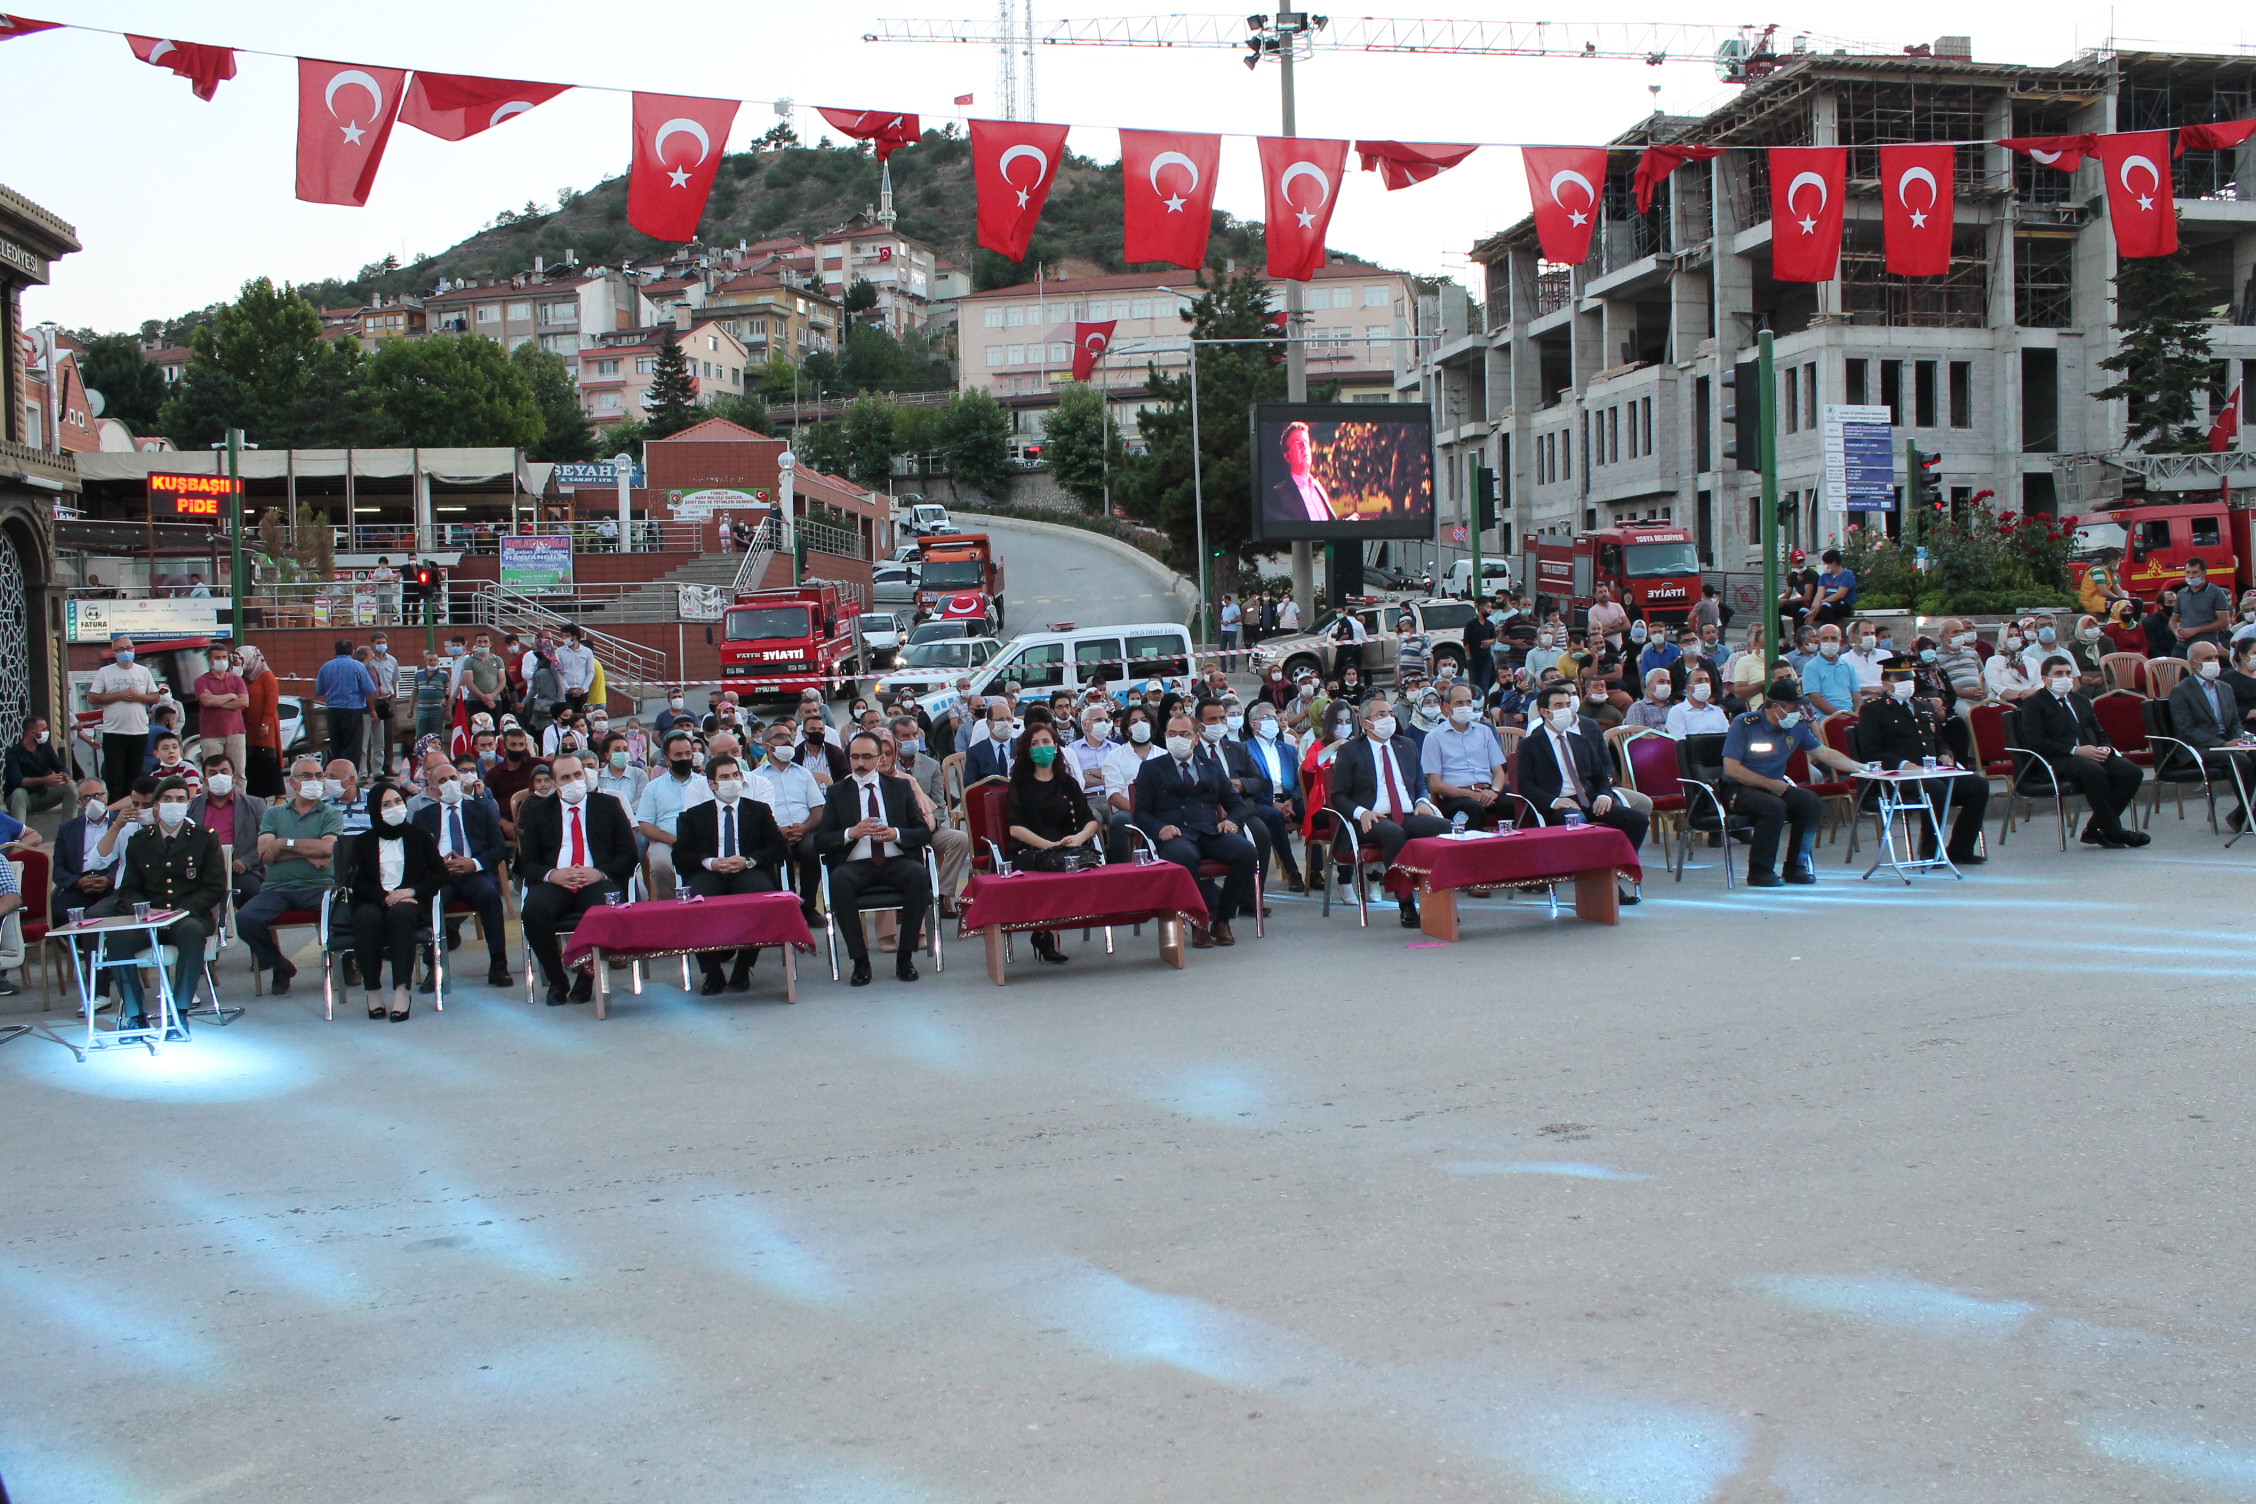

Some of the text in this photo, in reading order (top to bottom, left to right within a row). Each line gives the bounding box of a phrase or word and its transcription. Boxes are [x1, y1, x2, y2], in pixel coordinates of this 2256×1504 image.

[0, 238, 38, 273] LEDİYESİ
[555, 464, 637, 477] SEYAHT
[1635, 533, 1684, 543] TOSYA BELEDİYESİ
